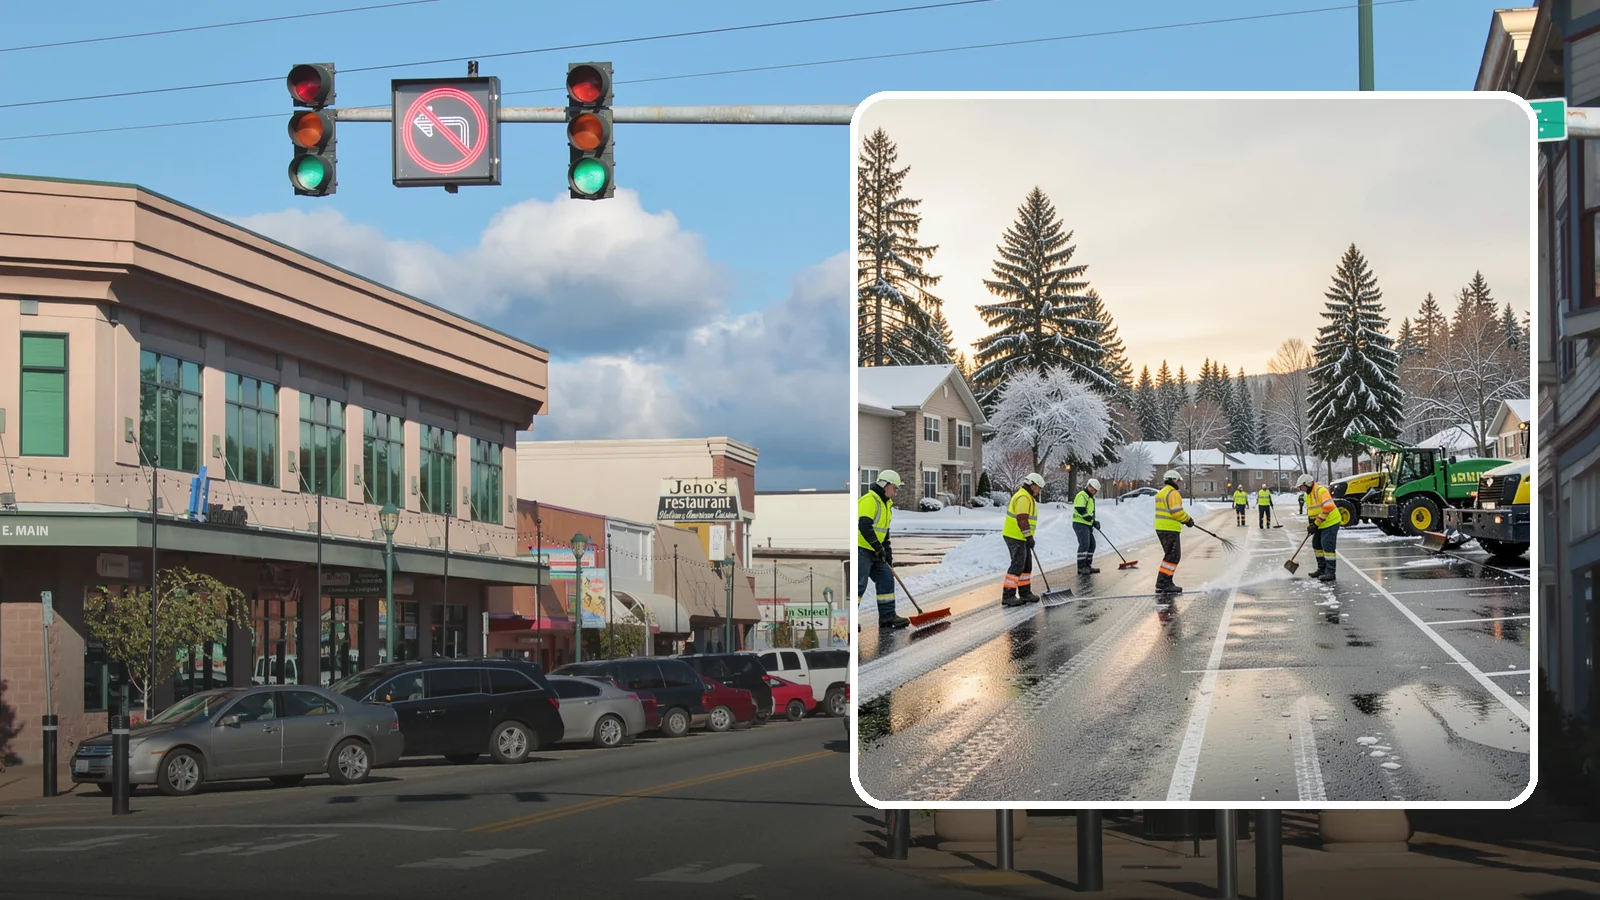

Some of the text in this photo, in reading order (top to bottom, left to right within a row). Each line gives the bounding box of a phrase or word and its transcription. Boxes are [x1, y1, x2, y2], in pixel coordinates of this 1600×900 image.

[670, 480, 727, 494] Jeno's
[665, 496, 731, 509] restaurant
[658, 509, 681, 519] Italian
[686, 509, 715, 519] American
[715, 509, 737, 519] Cuisine
[2, 525, 49, 536] E. MAIN
[786, 607, 829, 617] in Street
[791, 619, 823, 627] lass
